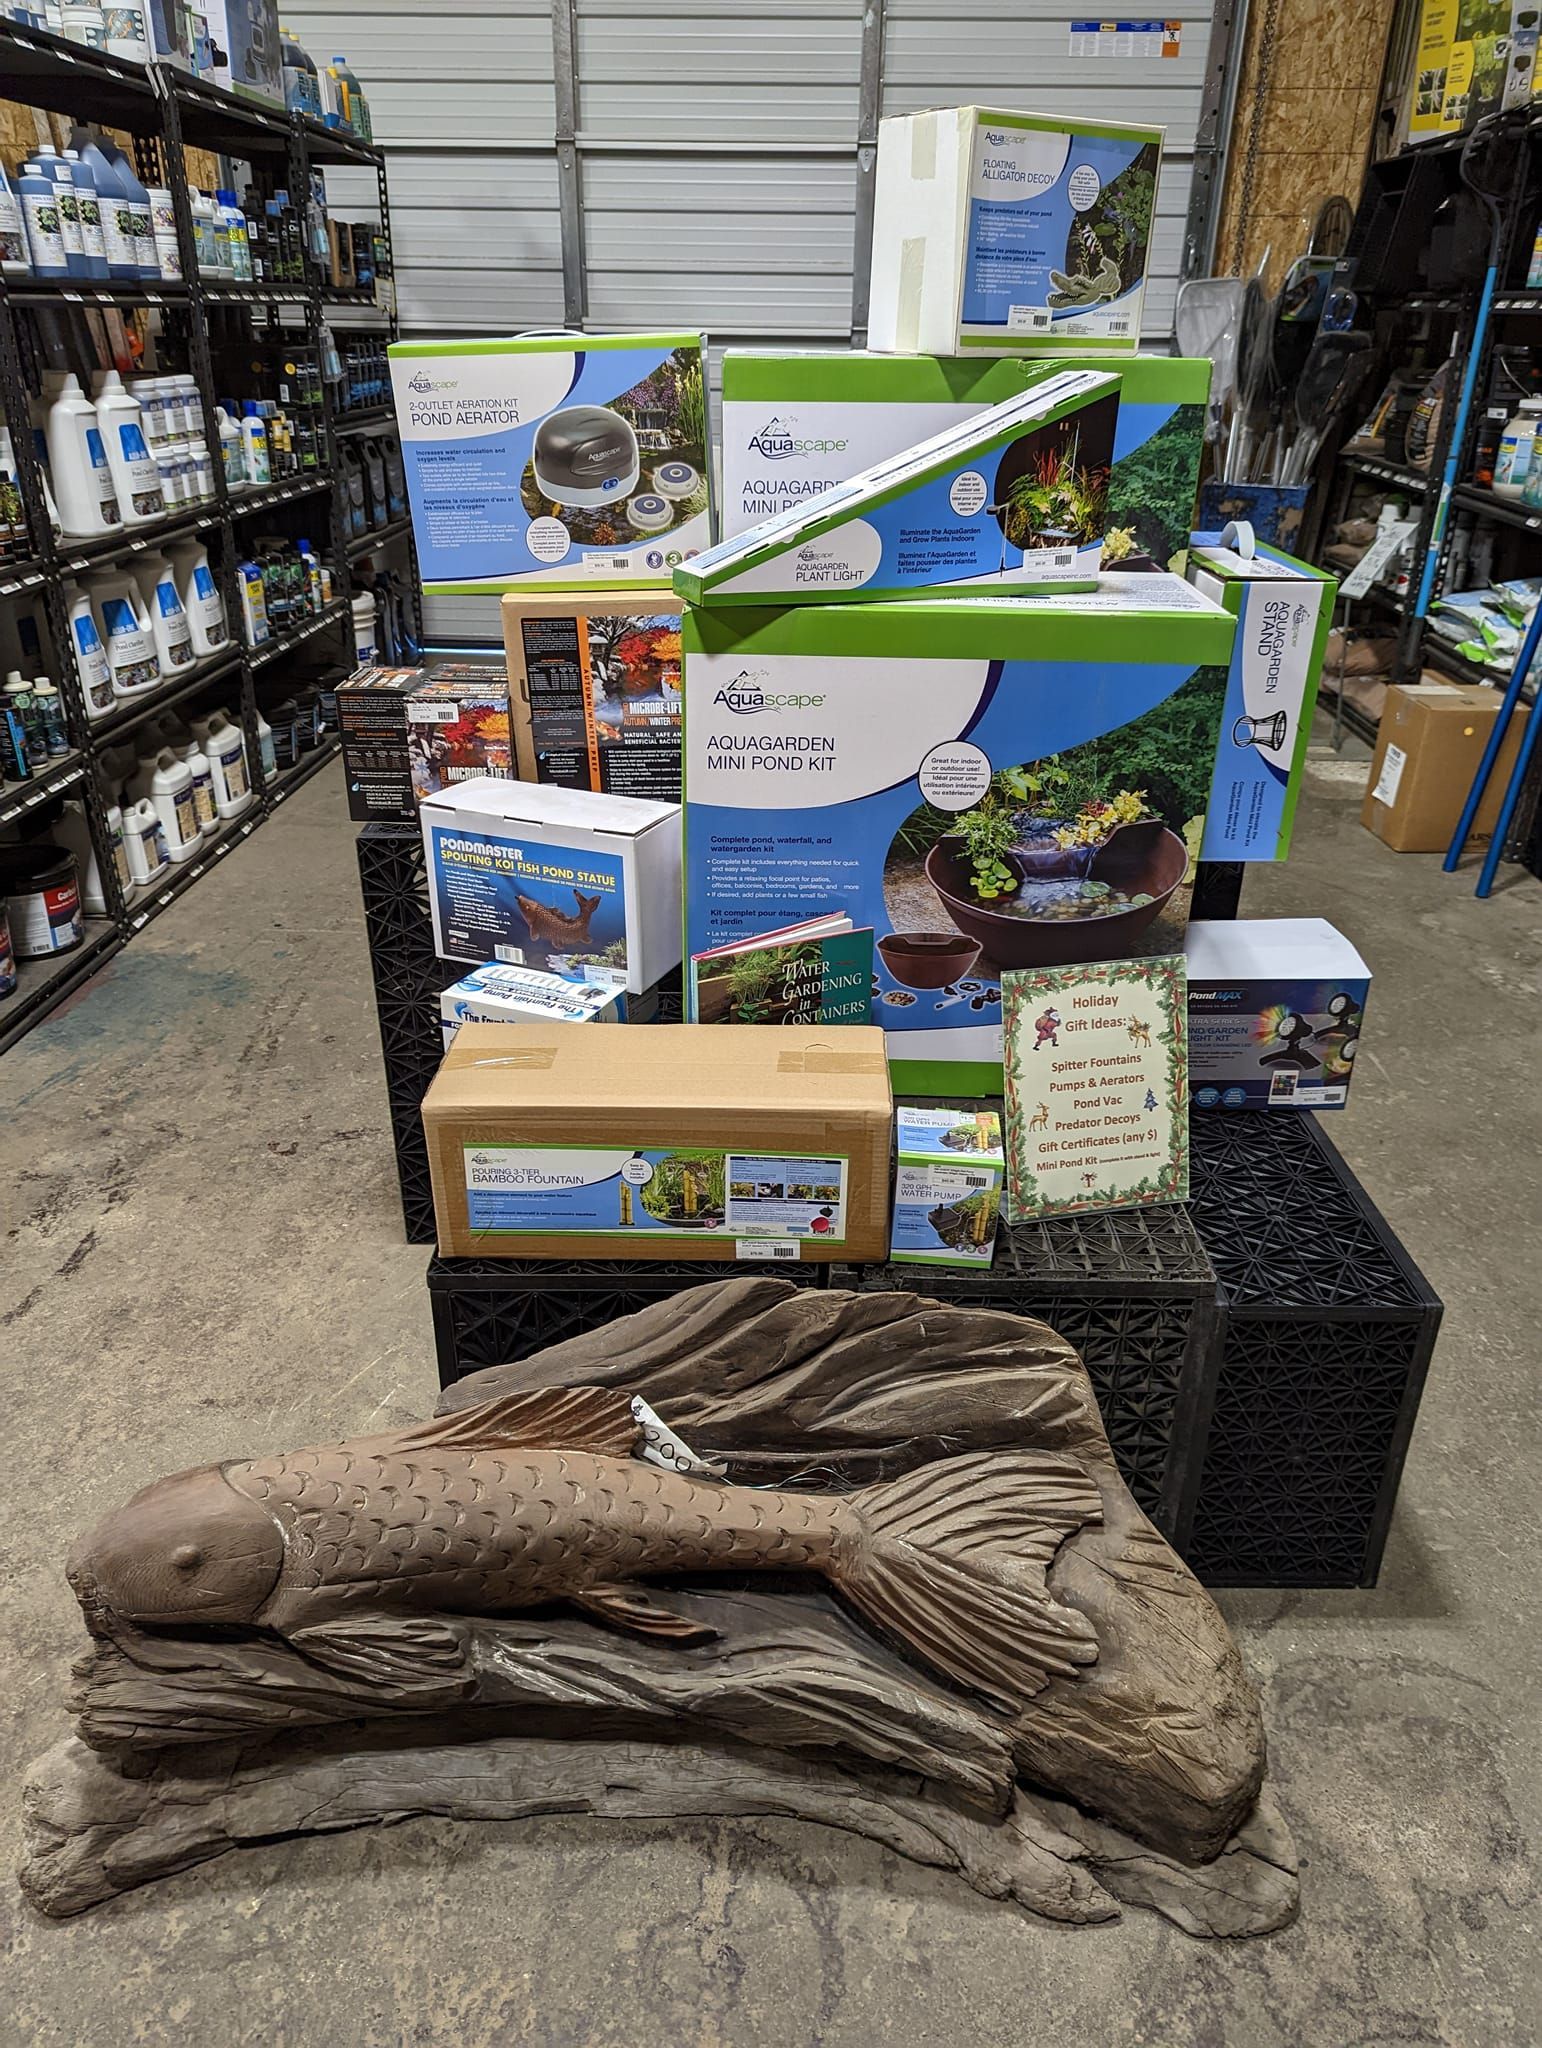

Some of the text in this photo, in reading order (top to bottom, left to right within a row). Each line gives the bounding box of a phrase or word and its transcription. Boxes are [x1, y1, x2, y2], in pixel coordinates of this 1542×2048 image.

[983, 159, 1016, 170] FLOATING
[982, 169, 1055, 185] ALLIGATOR DECOY
[408, 380, 458, 391] Aquascape
[409, 398, 518, 411] 2-OUTLET AERATION KIT
[411, 410, 520, 426] POND AERATOR
[748, 436, 848, 453] Aquascape
[743, 480, 844, 494] AQUAGARD
[743, 500, 777, 513] MINI
[900, 528, 931, 536] Illuminate
[943, 527, 981, 535] AquaGarden
[796, 563, 849, 571] AQUAGARDEN
[898, 559, 915, 567] faites
[916, 559, 942, 567] pousser
[955, 558, 978, 566] plantes
[796, 570, 864, 582] PLANT LIGHT
[1041, 573, 1092, 582] aquascapeinc.com
[1258, 601, 1279, 656] STAND
[1265, 601, 1290, 694] AQUAGARDEN
[713, 690, 826, 709] Aquascape
[583, 668, 595, 745] AUTUMN/WINTER
[629, 701, 682, 714] MICROBE-LIFT
[707, 735, 835, 751] AQUAGARDEN
[708, 755, 837, 771] MINI POND KIT
[710, 835, 832, 845] Complete pond, waterfall, and
[439, 836, 523, 861] PONDMASTER
[710, 845, 775, 853] watergarden kit
[440, 849, 492, 867] SPOUTING
[495, 858, 514, 870] KOI
[517, 861, 540, 875] FISH
[542, 865, 574, 880] POND
[577, 871, 616, 886] STATUE
[711, 858, 741, 866] Complete
[777, 859, 808, 867] everything
[744, 875, 768, 883] relaxing
[724, 909, 756, 917] complet
[778, 909, 803, 918] étang,
[720, 918, 743, 926] jardin
[782, 958, 830, 981] WATER
[782, 972, 862, 1006] GARDENING
[1073, 995, 1119, 1009] Holiday
[1188, 991, 1242, 1001] PondMAX
[799, 998, 811, 1011] in
[463, 1011, 480, 1023] The
[782, 1000, 865, 1025] CONTAINERS
[1065, 1017, 1127, 1032] Gift Ideas:
[1207, 1027, 1249, 1035] GARDEN
[1051, 1054, 1142, 1074] Spitter Fountains
[1050, 1073, 1145, 1093] Pumps & Aerators
[1074, 1095, 1122, 1109] Pond Vac
[1056, 1112, 1141, 1132] Predator Decoys
[1038, 1129, 1158, 1153] Gift Certificates (any $)
[1037, 1156, 1098, 1171] Mini Pond Kit
[472, 1168, 539, 1176] POURING 3-TIER
[472, 1175, 584, 1185] BAMBOO FOUNTAIN
[901, 1189, 962, 1200] WATER PUMP
